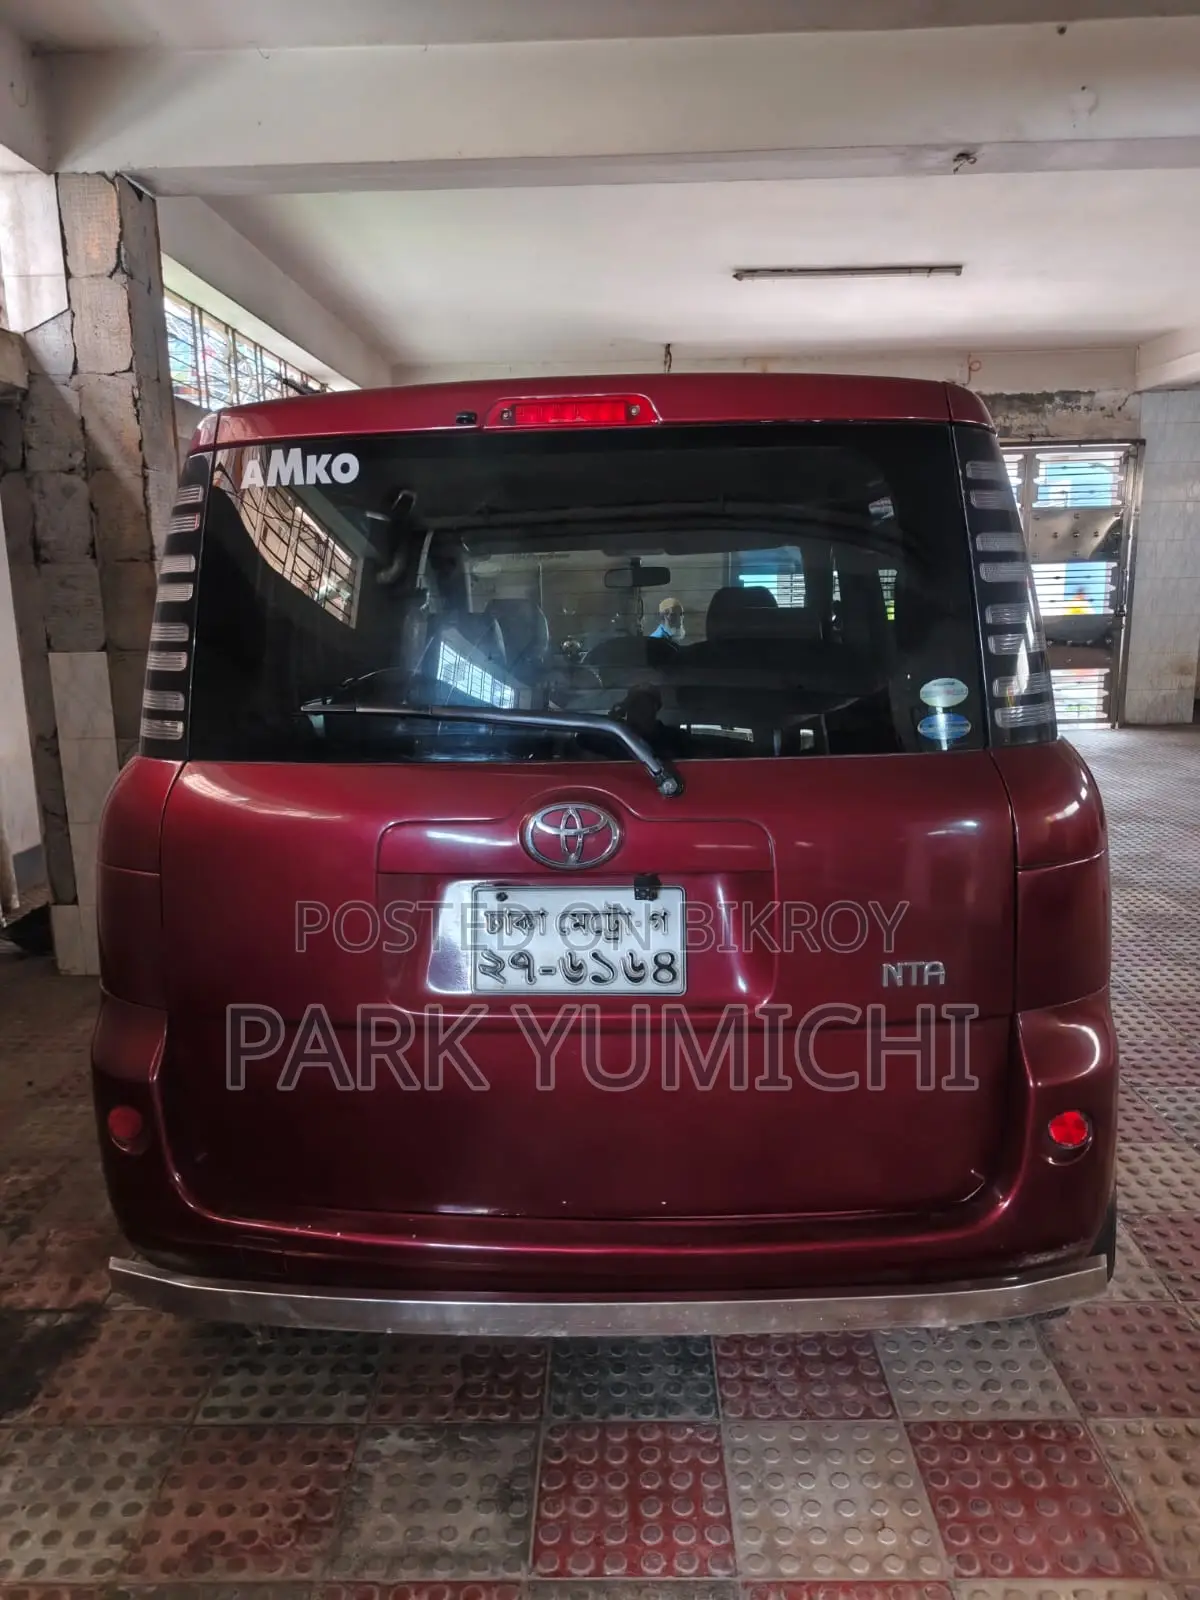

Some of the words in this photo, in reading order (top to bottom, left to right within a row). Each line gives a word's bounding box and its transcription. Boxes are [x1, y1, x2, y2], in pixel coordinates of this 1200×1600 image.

[240, 447, 360, 490] AMKO
[484, 907, 548, 936] ঢাকা
[478, 949, 678, 986] ২৭-৬১৬৪
[882, 961, 946, 987] NTA
